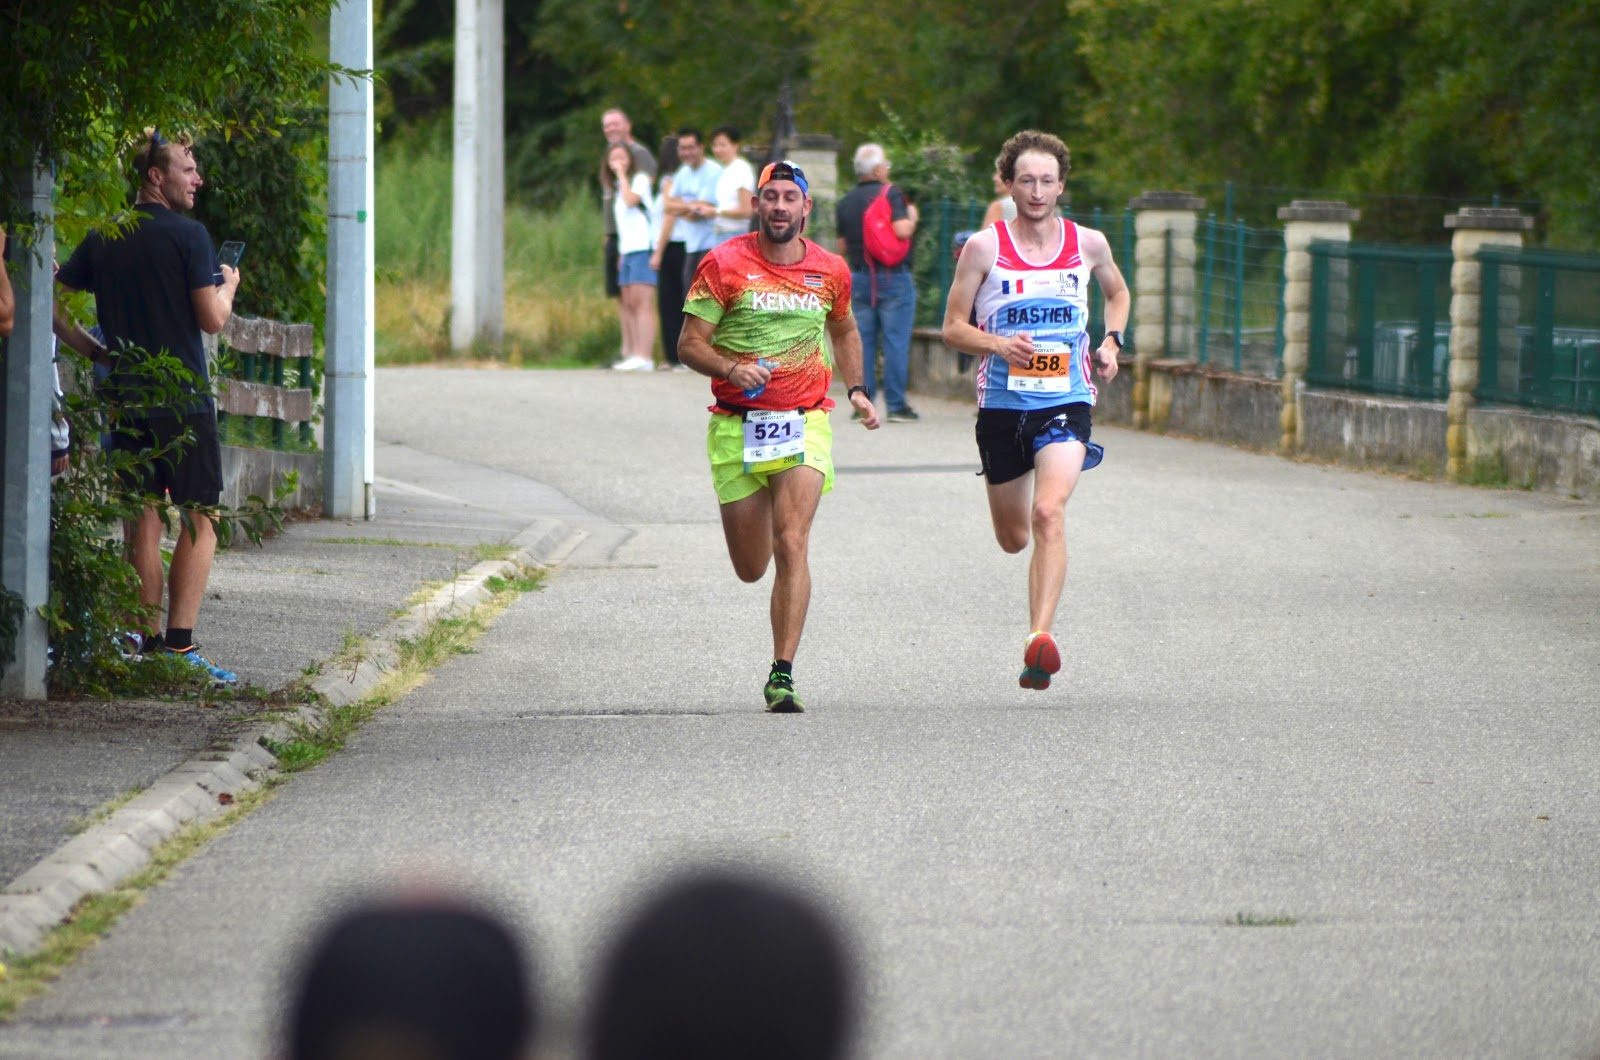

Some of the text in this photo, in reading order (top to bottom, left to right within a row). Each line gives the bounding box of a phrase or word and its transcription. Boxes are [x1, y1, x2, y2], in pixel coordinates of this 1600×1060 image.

[752, 291, 823, 312] KENYA
[1007, 307, 1073, 324] BASTIEN
[754, 421, 791, 440] 521
